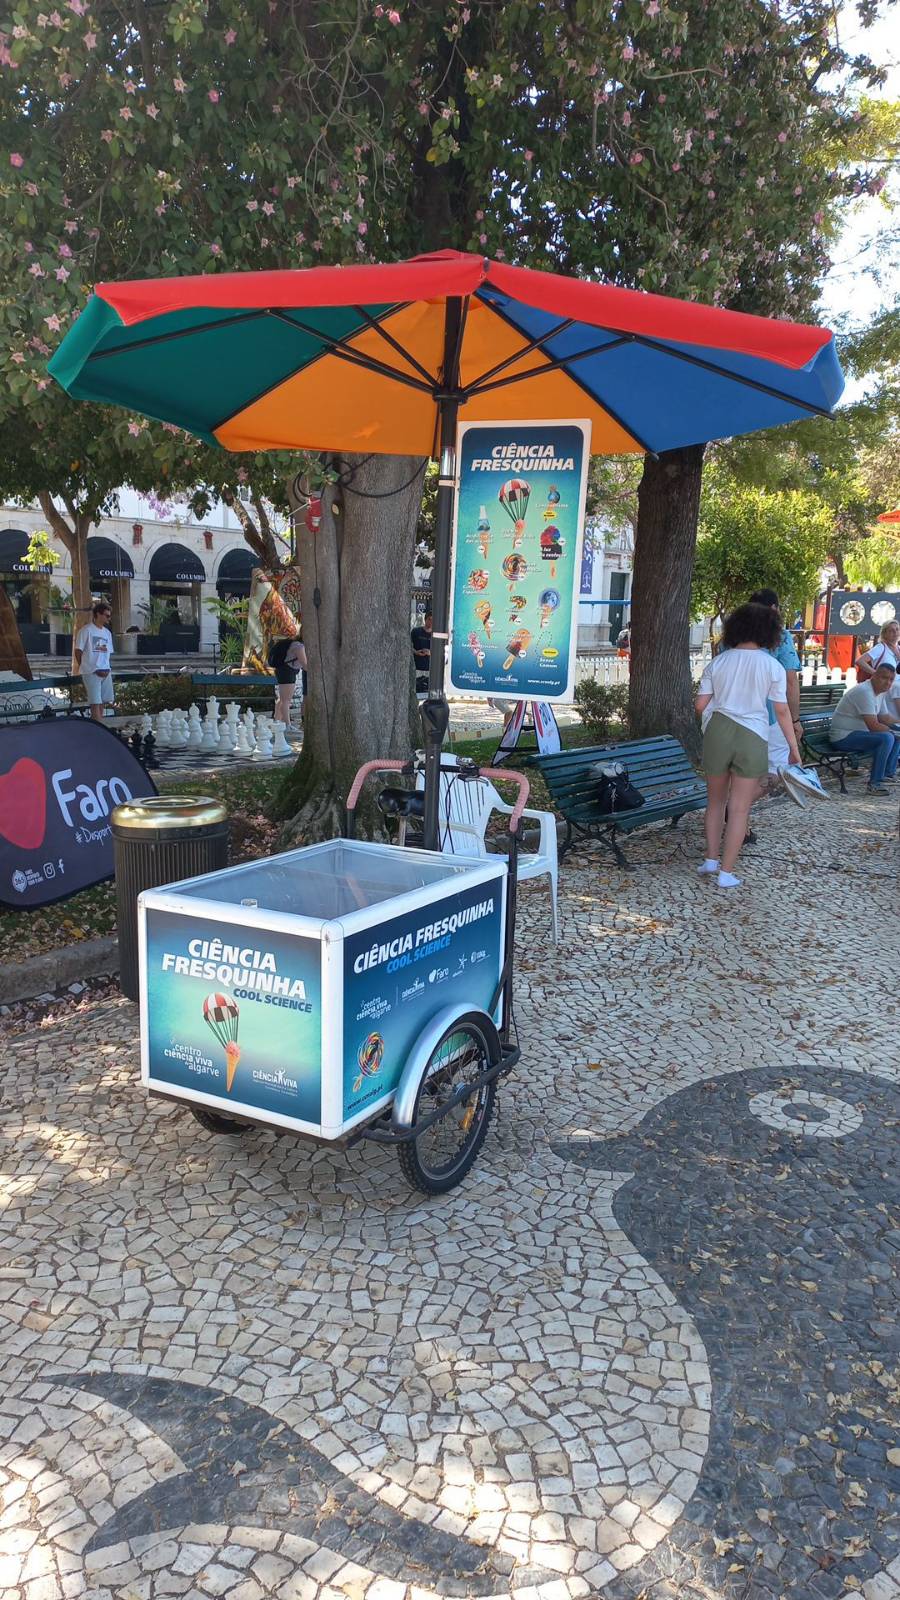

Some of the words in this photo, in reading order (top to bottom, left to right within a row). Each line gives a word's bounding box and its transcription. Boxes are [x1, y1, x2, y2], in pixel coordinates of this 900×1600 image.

[491, 442, 555, 458] CIÊNCIA
[471, 458, 575, 473] FRESQUINHA
[52, 768, 133, 828] Faro
[353, 934, 412, 974] CIÊNCIA
[415, 898, 494, 948] FRESQUINHA
[188, 938, 277, 973] CIÊNCIA
[386, 952, 412, 974] COOL
[413, 934, 452, 963] SCIENCE
[161, 953, 306, 1000] FRESQUINHA
[436, 967, 449, 980] Faro
[233, 987, 263, 1003] COOL
[264, 994, 313, 1014] SCIENCE
[164, 1048, 194, 1063] ciência
[195, 1056, 213, 1067] viva
[174, 1043, 202, 1057] centro
[188, 1060, 220, 1077] algarve
[252, 1069, 278, 1084] CIÊNCIA
[283, 1077, 298, 1089] VIVA
